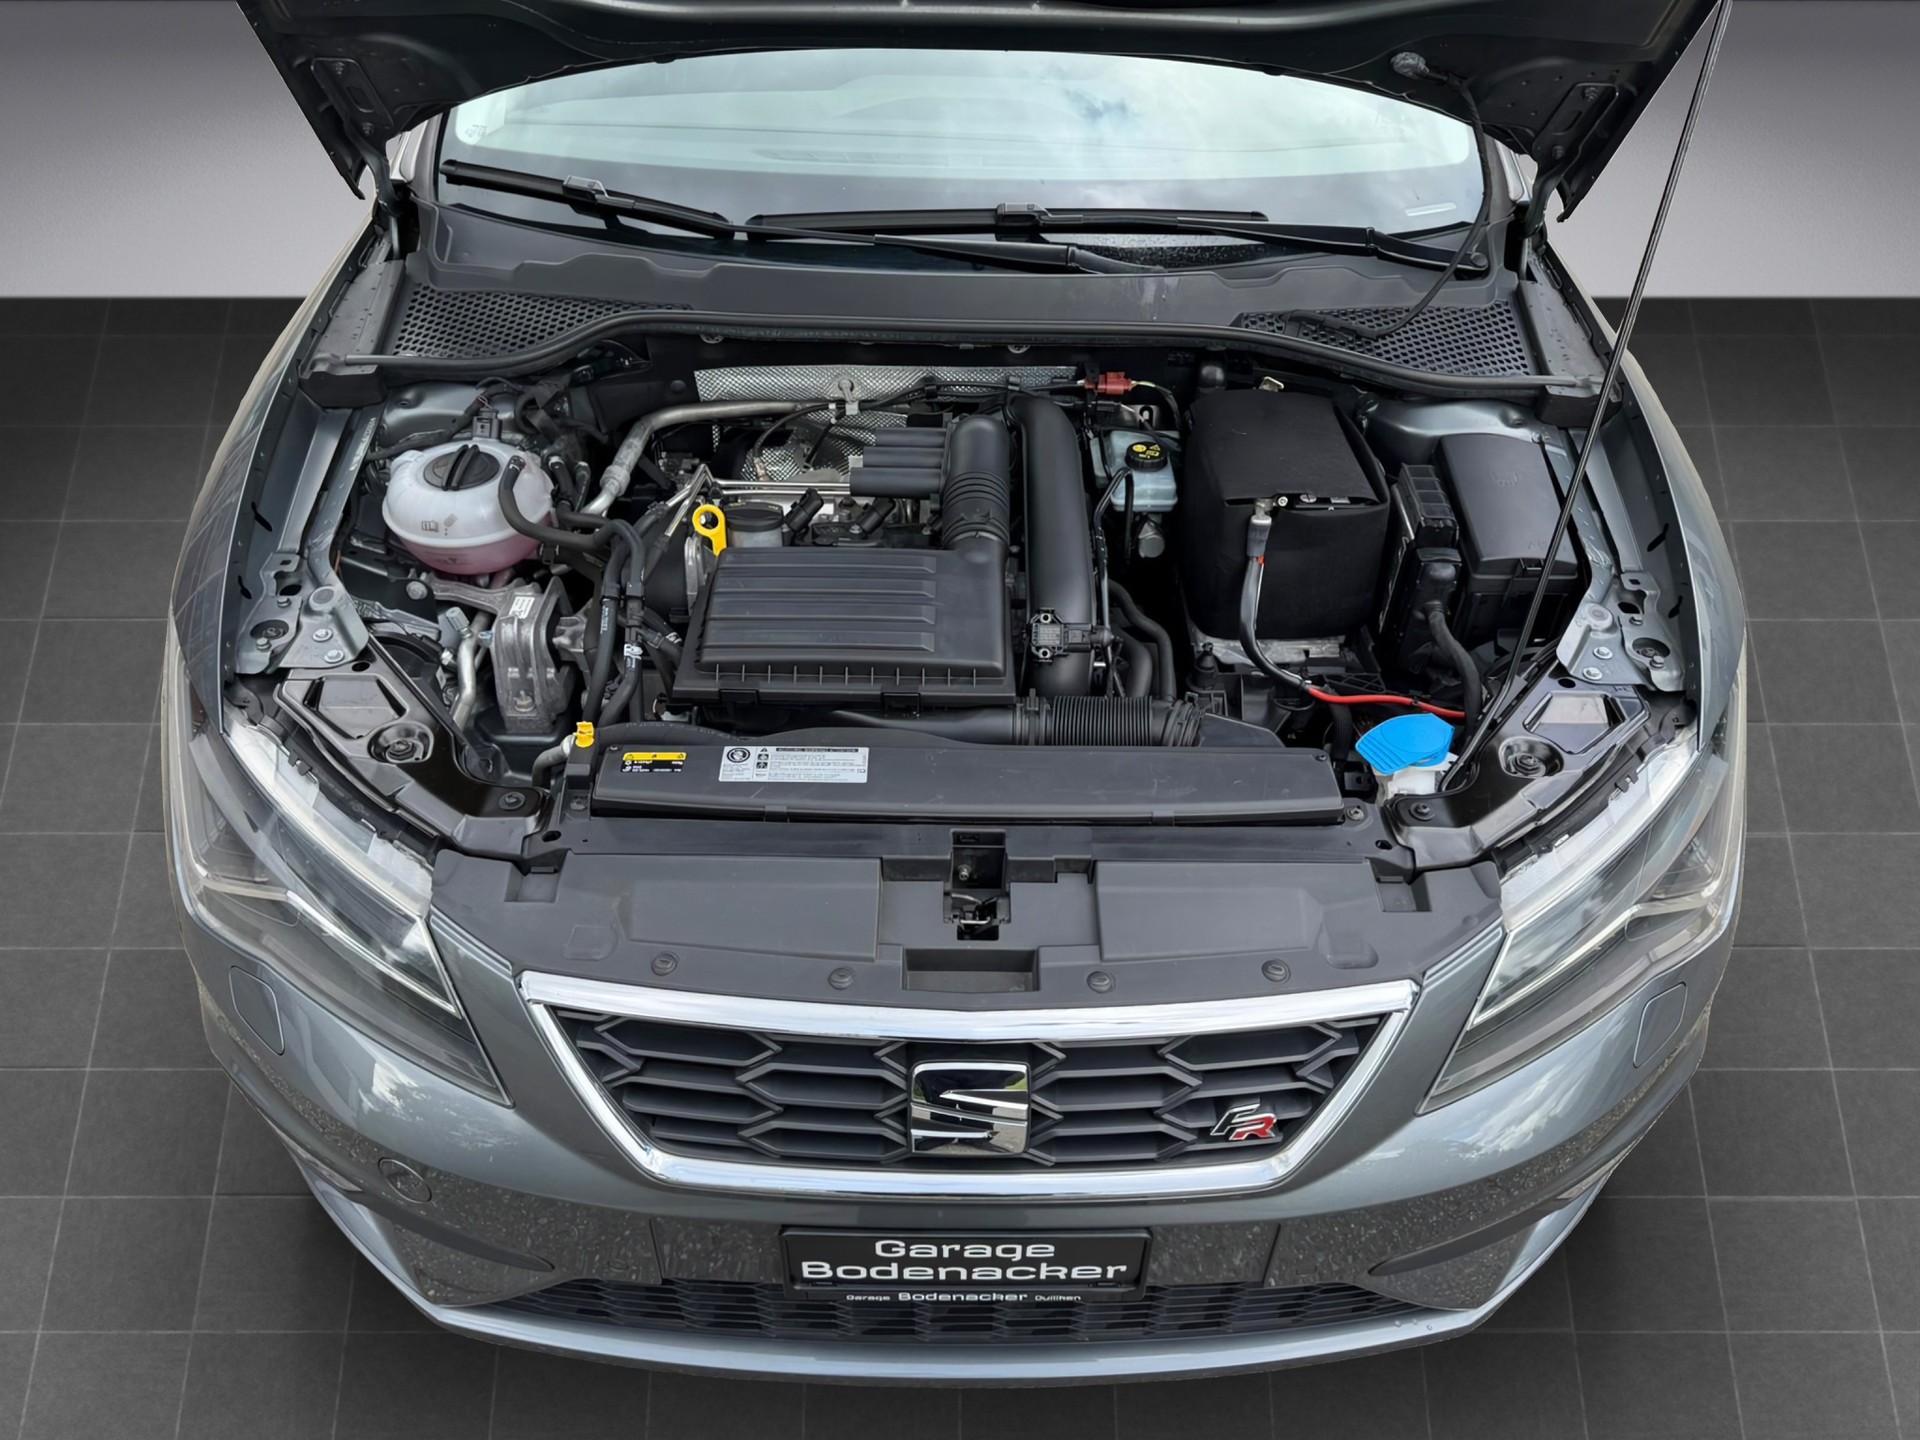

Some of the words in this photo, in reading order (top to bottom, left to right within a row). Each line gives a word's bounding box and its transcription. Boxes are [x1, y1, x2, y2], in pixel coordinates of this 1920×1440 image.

[1210, 1103, 1277, 1141] FR
[875, 1240, 1055, 1262] Garage
[801, 1261, 1127, 1281] Bodenacker
[846, 1294, 891, 1302] Garage
[898, 1292, 1028, 1301] Bodenacker
